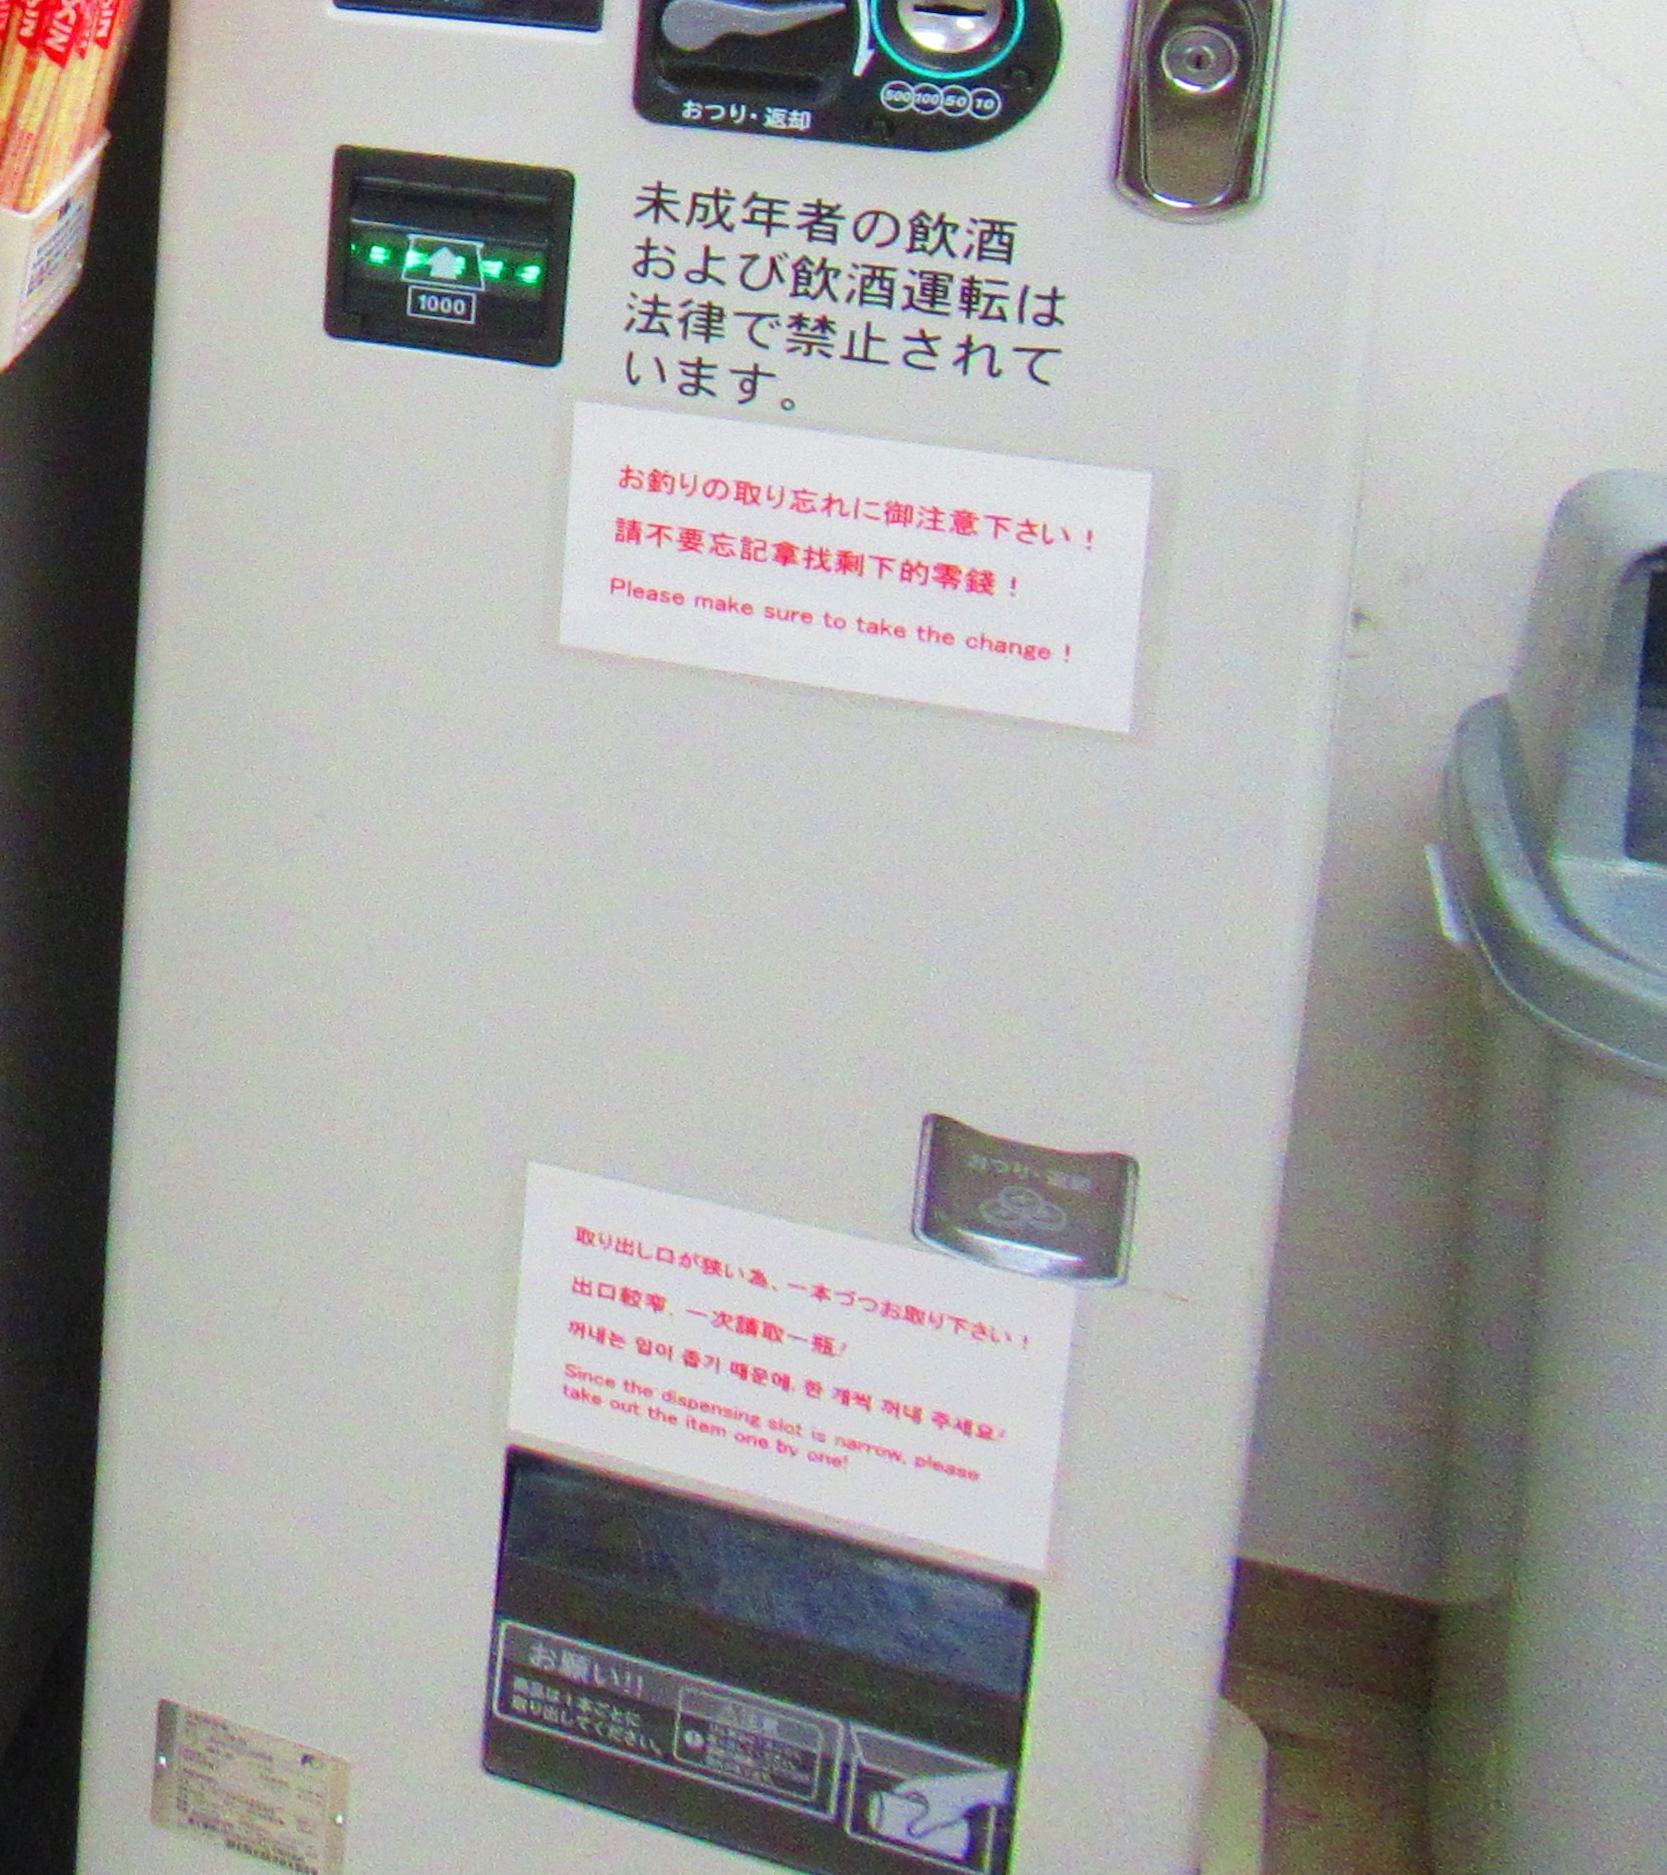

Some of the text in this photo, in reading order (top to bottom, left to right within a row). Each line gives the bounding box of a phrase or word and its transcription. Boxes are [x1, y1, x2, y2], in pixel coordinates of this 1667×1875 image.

[681, 98, 813, 131] おつり・返却
[885, 88, 995, 111] 500 100 50 10
[633, 180, 1019, 265] 未成年者の飲酒
[417, 292, 466, 316] 1000
[632, 237, 1067, 328] および飲酒運転は
[624, 292, 1064, 387] 法律で禁止されて
[626, 350, 796, 413] います。
[619, 463, 1096, 551] お釣りの取り忘れに御注意下さい！
[610, 577, 686, 607] Please
[693, 592, 755, 617] make
[763, 605, 814, 626] sure
[823, 611, 847, 631] to
[855, 615, 906, 639] take
[916, 623, 955, 647] the
[964, 632, 1053, 662] change
[562, 1383, 603, 1406] take
[609, 1398, 642, 1417] out
[647, 1405, 679, 1426] the
[685, 1414, 728, 1438] item
[733, 1430, 770, 1449] one
[564, 1362, 617, 1389] Since
[622, 1377, 655, 1398] the
[660, 1388, 761, 1429] dispensing
[810, 1428, 828, 1444] is
[803, 1378, 823, 1400] 한
